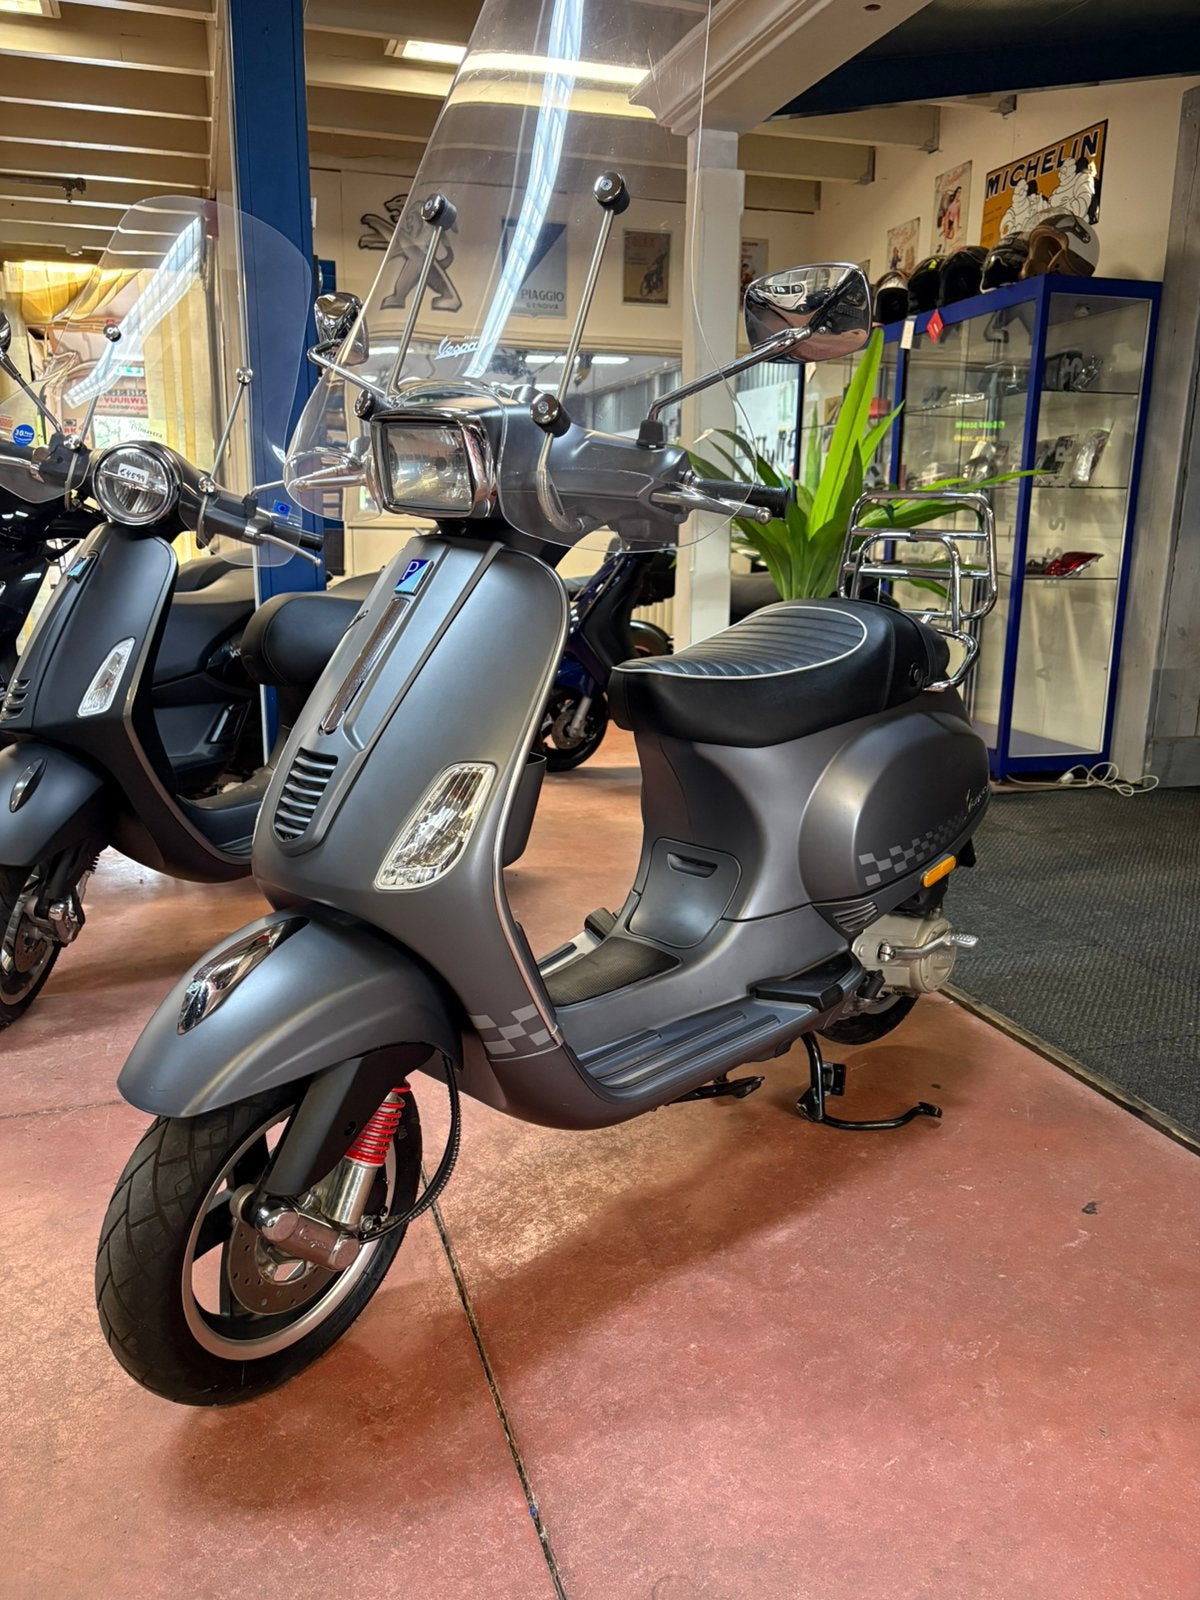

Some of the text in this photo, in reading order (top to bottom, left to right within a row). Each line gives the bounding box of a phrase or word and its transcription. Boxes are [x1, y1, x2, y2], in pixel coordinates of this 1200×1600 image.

[986, 129, 1100, 200] MICHELIN
[520, 289, 565, 302] PIAGGIO
[526, 302, 560, 310] GENOVA
[434, 335, 481, 361] Vespa
